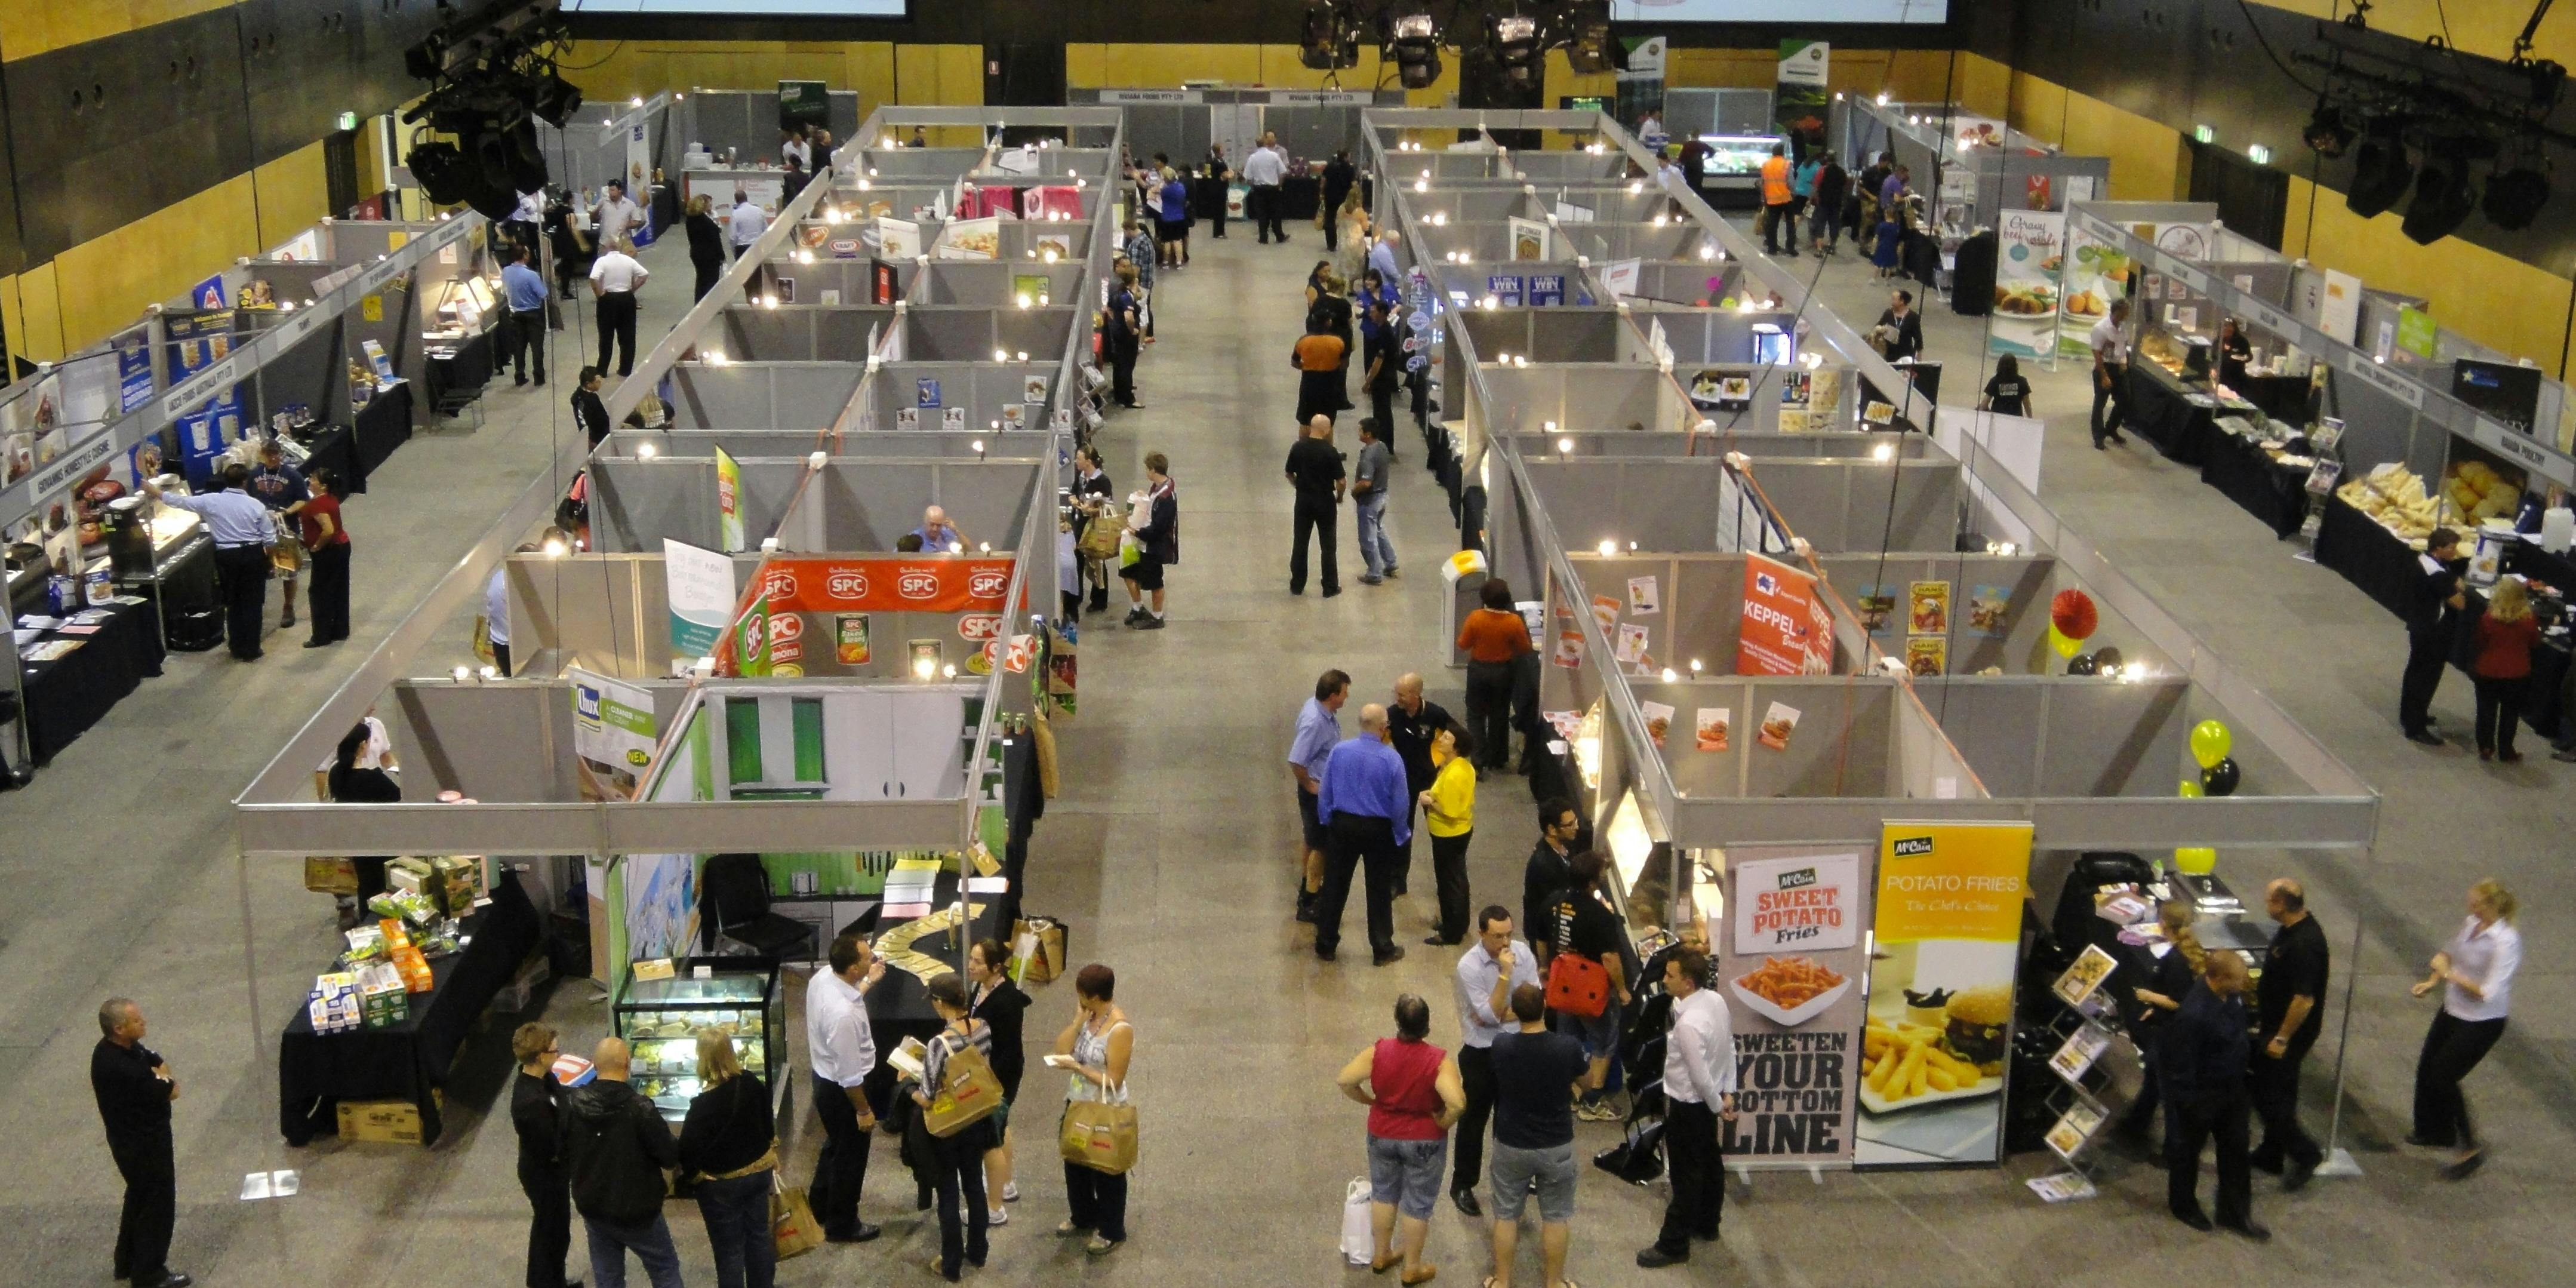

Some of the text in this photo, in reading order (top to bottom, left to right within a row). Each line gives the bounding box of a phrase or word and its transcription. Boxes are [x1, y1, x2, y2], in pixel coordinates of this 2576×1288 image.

[1493, 276, 1518, 290] WIN
[1534, 276, 1559, 290] WIN
[767, 579, 792, 595] SPC
[832, 579, 863, 592] SPC
[903, 579, 934, 592] SPC
[974, 578, 1004, 591] SPC
[1744, 599, 1797, 637] KEPPEL
[748, 619, 762, 653] SPC
[965, 619, 1002, 637] SPC
[627, 750, 647, 764] NEW
[1894, 837, 1934, 855] McCain
[1780, 871, 1817, 888] McCain
[1887, 875, 2020, 893] POTATO FRIES
[1757, 887, 1839, 912] SWEET
[1753, 906, 1843, 936] POTATO
[1775, 924, 1820, 945] Fries
[1732, 1032, 1848, 1053] SWEETEN
[1733, 1053, 1844, 1090] YOUR
[1722, 1114, 1842, 1155] LINE
